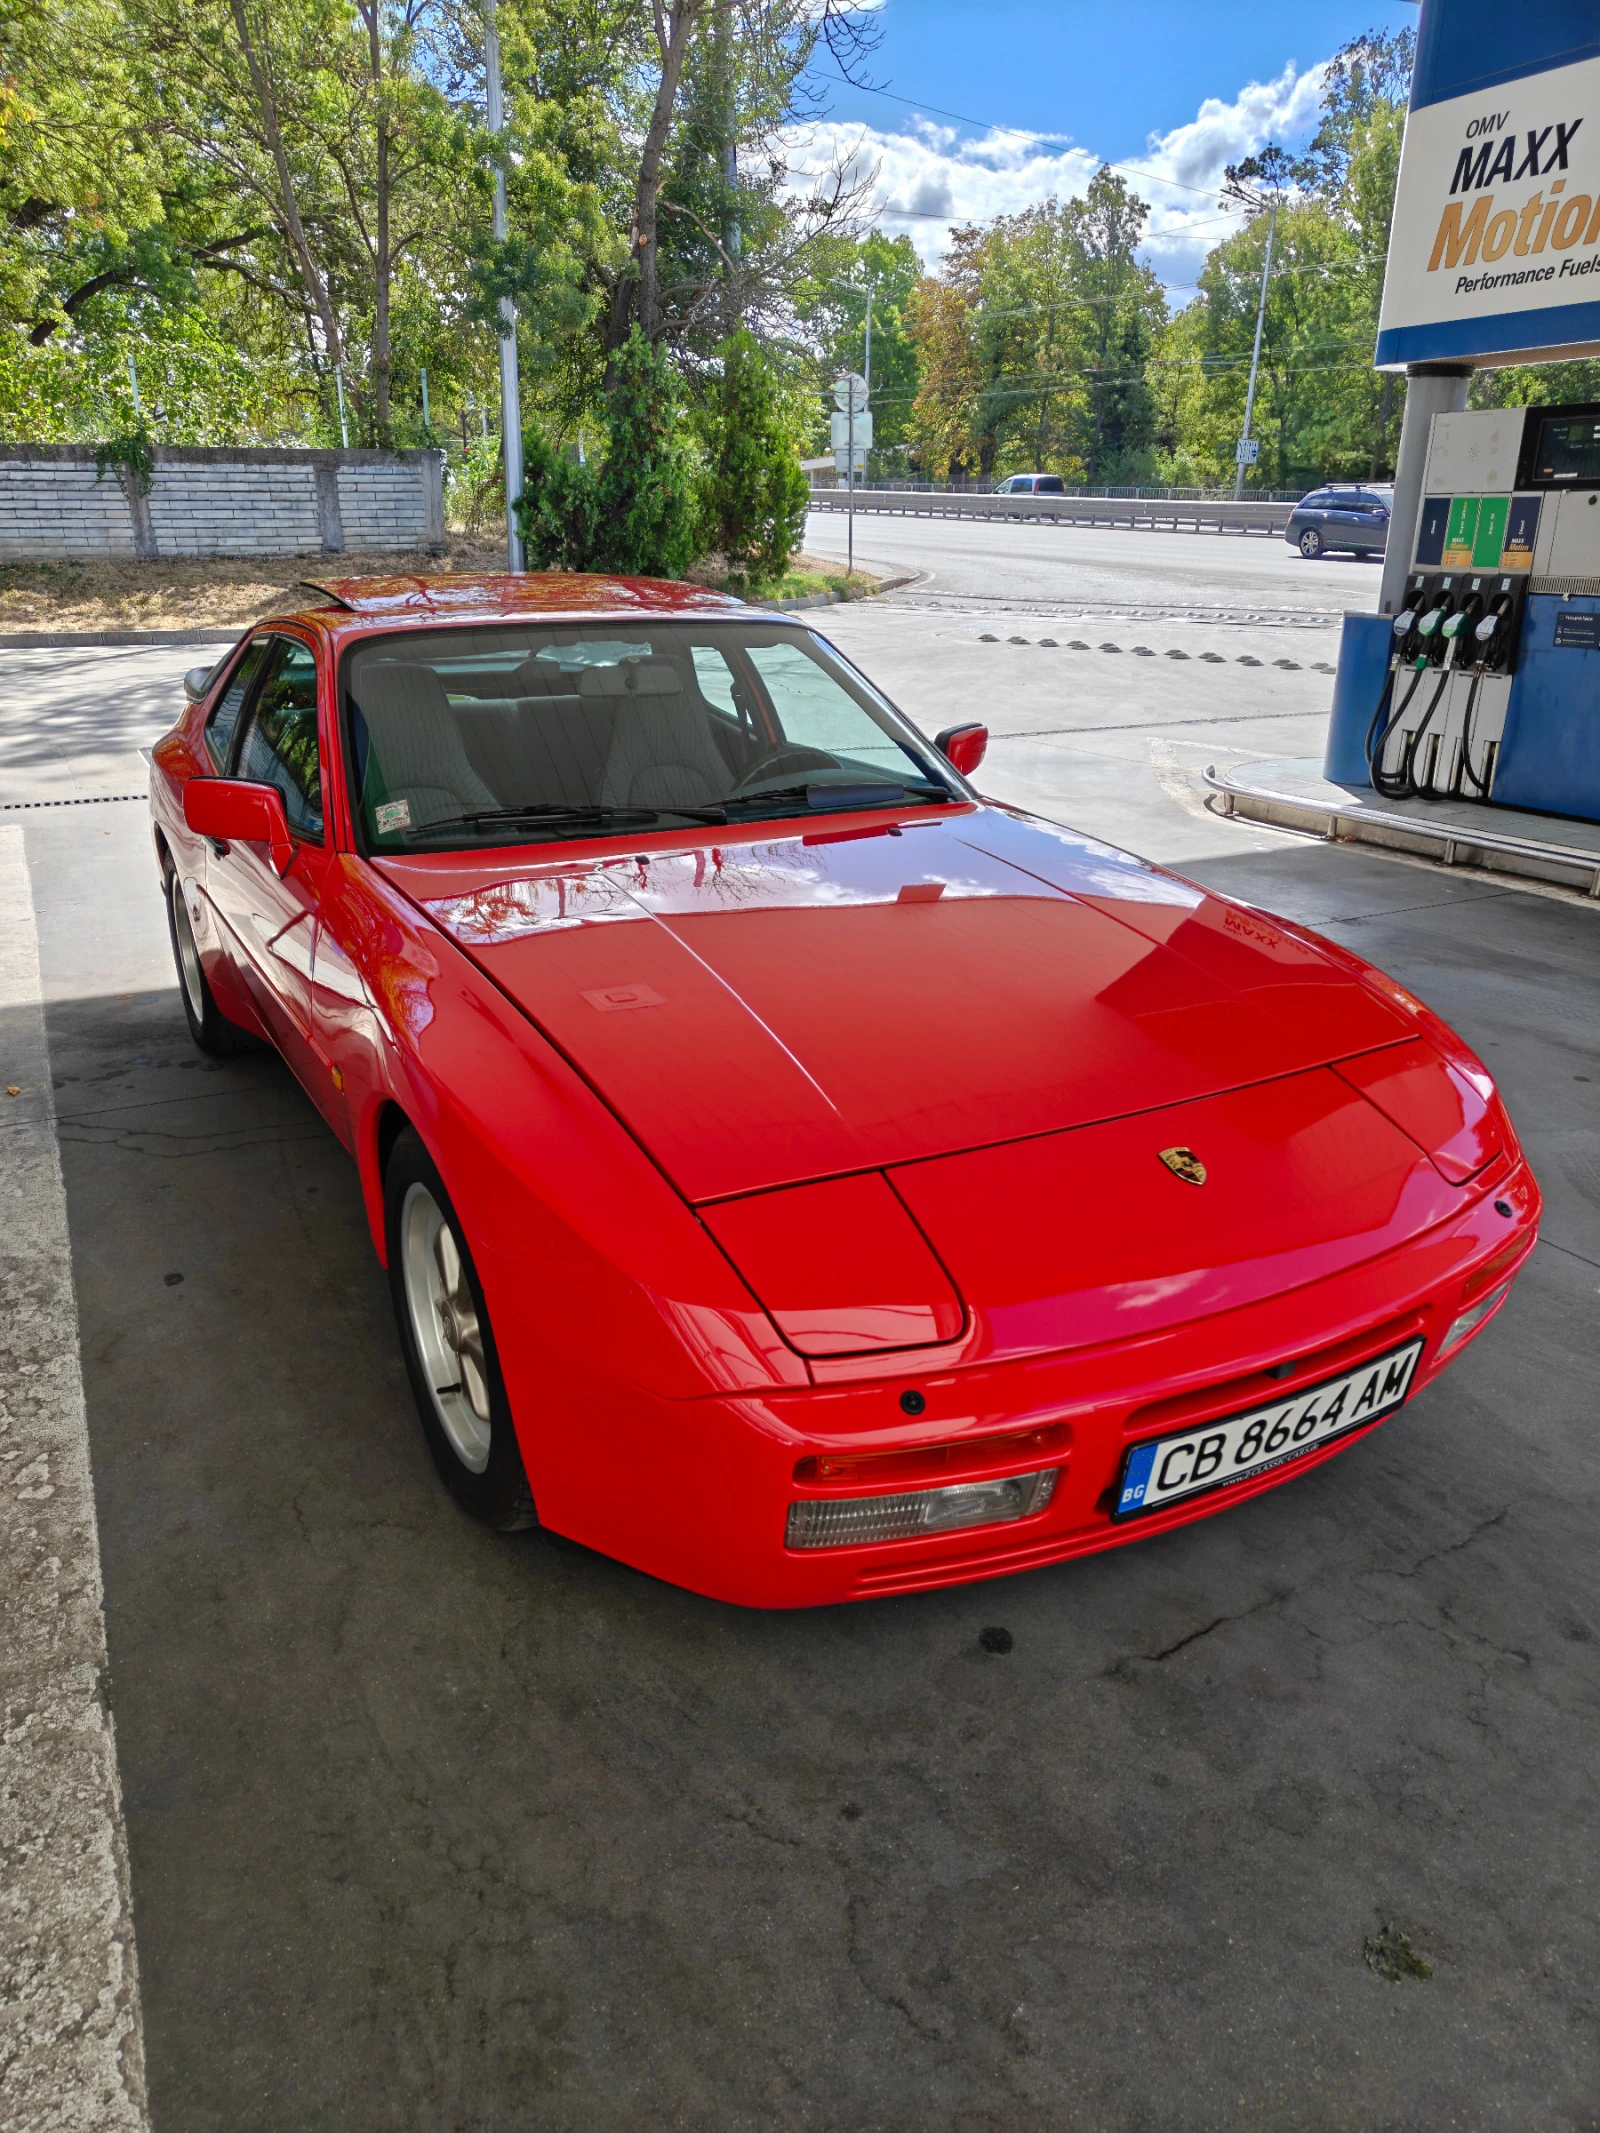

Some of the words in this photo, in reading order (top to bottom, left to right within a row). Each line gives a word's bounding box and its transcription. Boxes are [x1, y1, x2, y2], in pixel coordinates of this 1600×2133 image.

[1466, 110, 1510, 139] OMV
[1449, 118, 1584, 195] MAXX
[1455, 265, 1555, 294] Performance
[1156, 1432, 1227, 1491] CB
[1233, 1382, 1352, 1466] 8664
[1350, 1351, 1414, 1418] AM
[1122, 1483, 1145, 1504] BG
